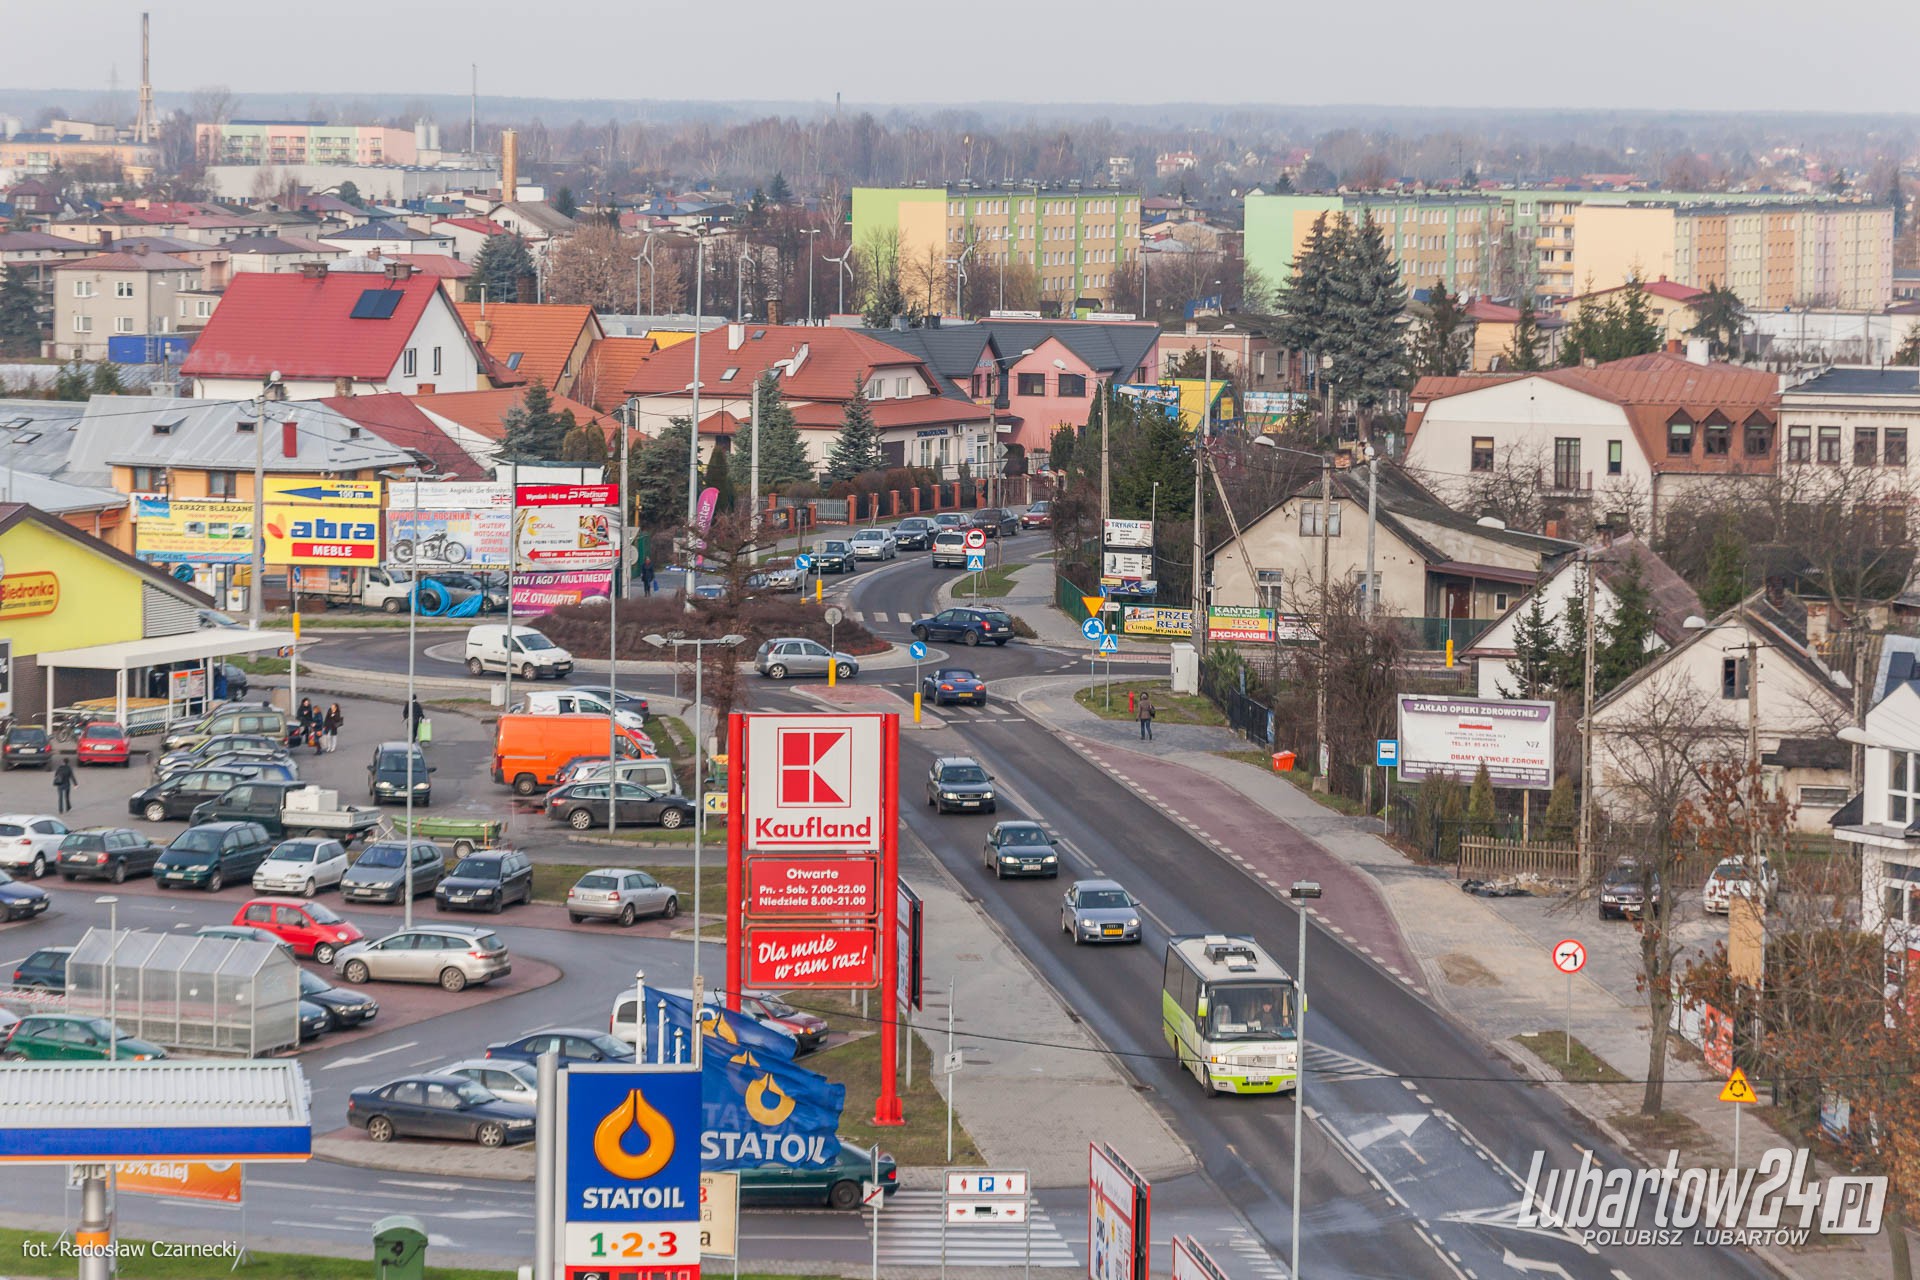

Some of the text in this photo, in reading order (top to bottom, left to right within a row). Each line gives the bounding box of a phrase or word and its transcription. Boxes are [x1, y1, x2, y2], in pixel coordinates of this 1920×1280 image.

[338, 491, 354, 499] 100
[578, 491, 609, 499] Platinum
[291, 518, 375, 540] abra
[312, 545, 352, 557] MEBLE
[513, 576, 530, 585] RTV
[536, 575, 553, 584] AGD
[560, 574, 612, 584] MULTIMEDIA
[513, 589, 577, 606] JUŻ OTWARTE!
[1214, 606, 1260, 616] KANTOR
[1210, 630, 1266, 640] EXCHANGE
[1414, 703, 1540, 718] ZAKŁAD OPIEKI ZDROWOTNEJ
[1478, 754, 1484, 762] O
[1512, 756, 1545, 766] ZDROWIE
[756, 816, 871, 838] Kaufland
[786, 868, 839, 880] Otwarte
[760, 885, 776, 894] Pn.
[786, 884, 808, 894] Sob.
[810, 884, 866, 894] 7.00-22.00
[759, 896, 866, 906] Niedziela 8.00-21.00
[758, 934, 837, 964] Dla mnie
[774, 946, 868, 980] w sam raz!
[701, 1130, 826, 1165] STATOIL
[150, 1162, 189, 1183] dalej
[583, 1186, 685, 1209] STATOIL
